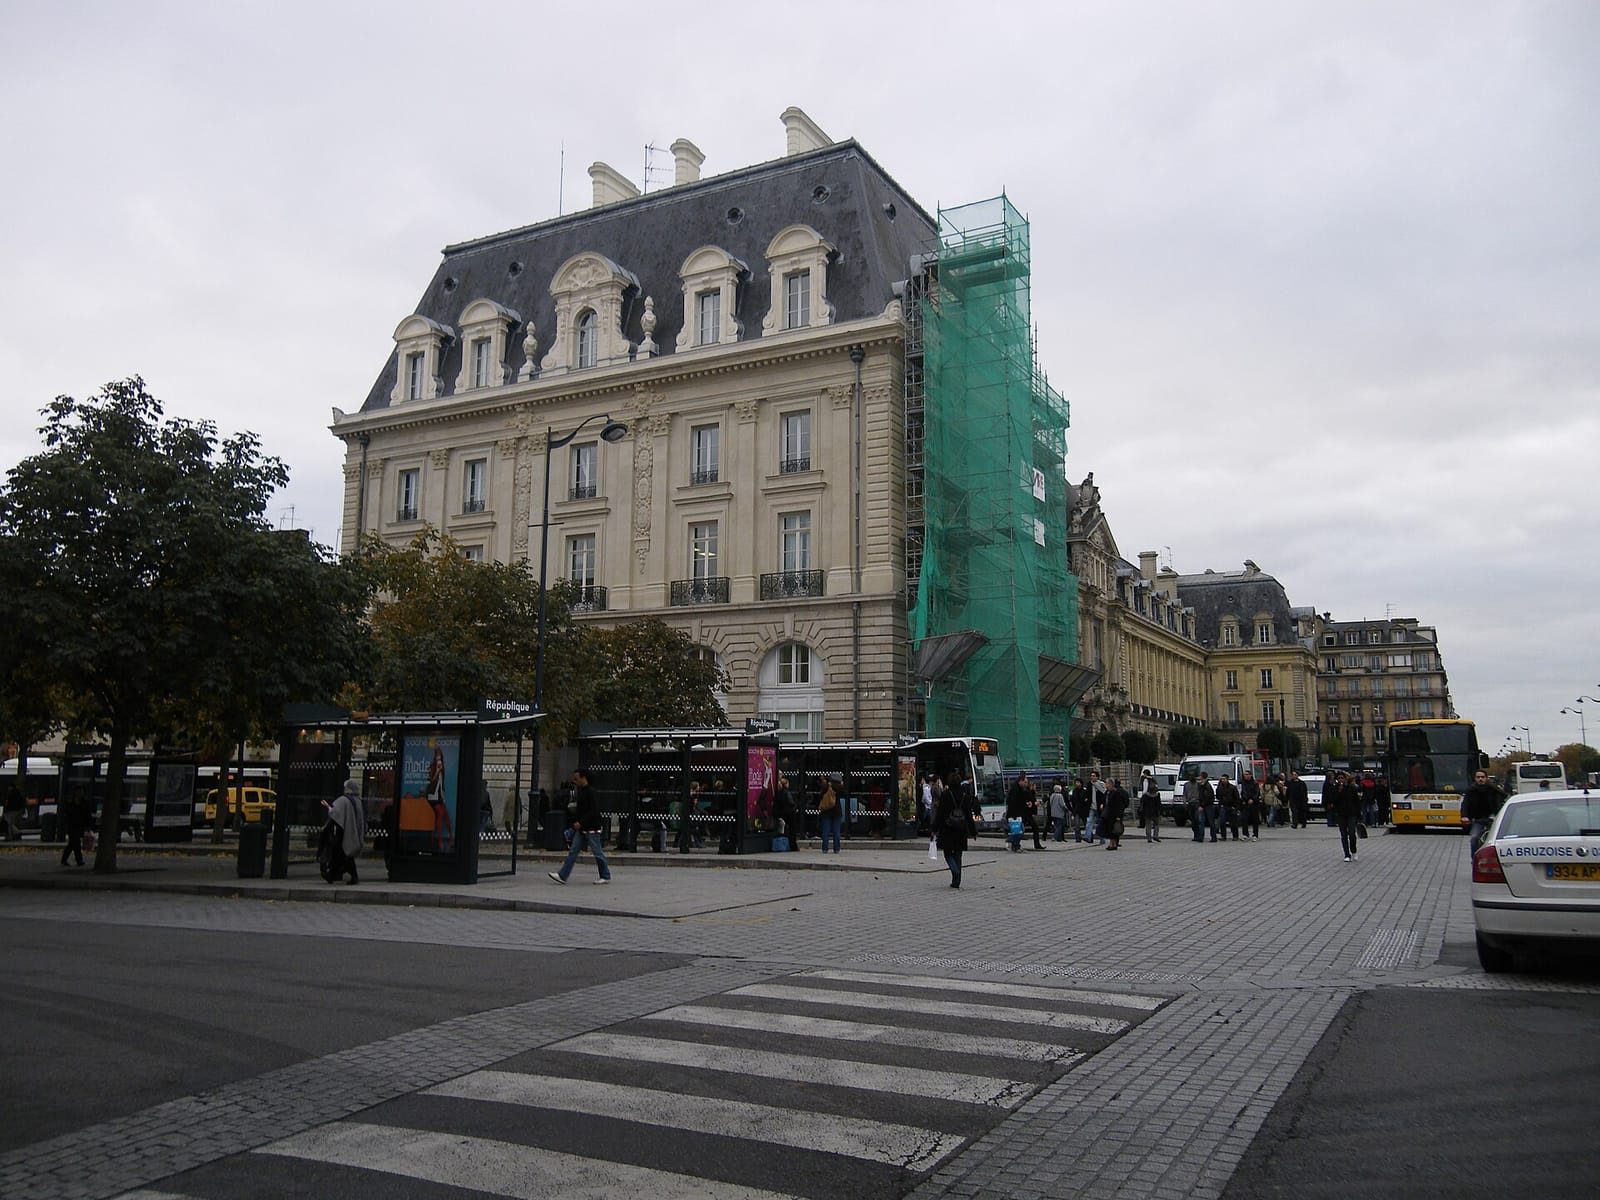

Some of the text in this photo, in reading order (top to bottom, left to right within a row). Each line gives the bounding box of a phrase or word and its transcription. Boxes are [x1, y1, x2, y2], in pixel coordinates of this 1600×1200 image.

[485, 699, 530, 713] République
[405, 757, 431, 772] mode
[1499, 847, 1513, 857] LA
[1516, 846, 1573, 857] BRUZOISE
[1553, 866, 1600, 878] 934 AP
